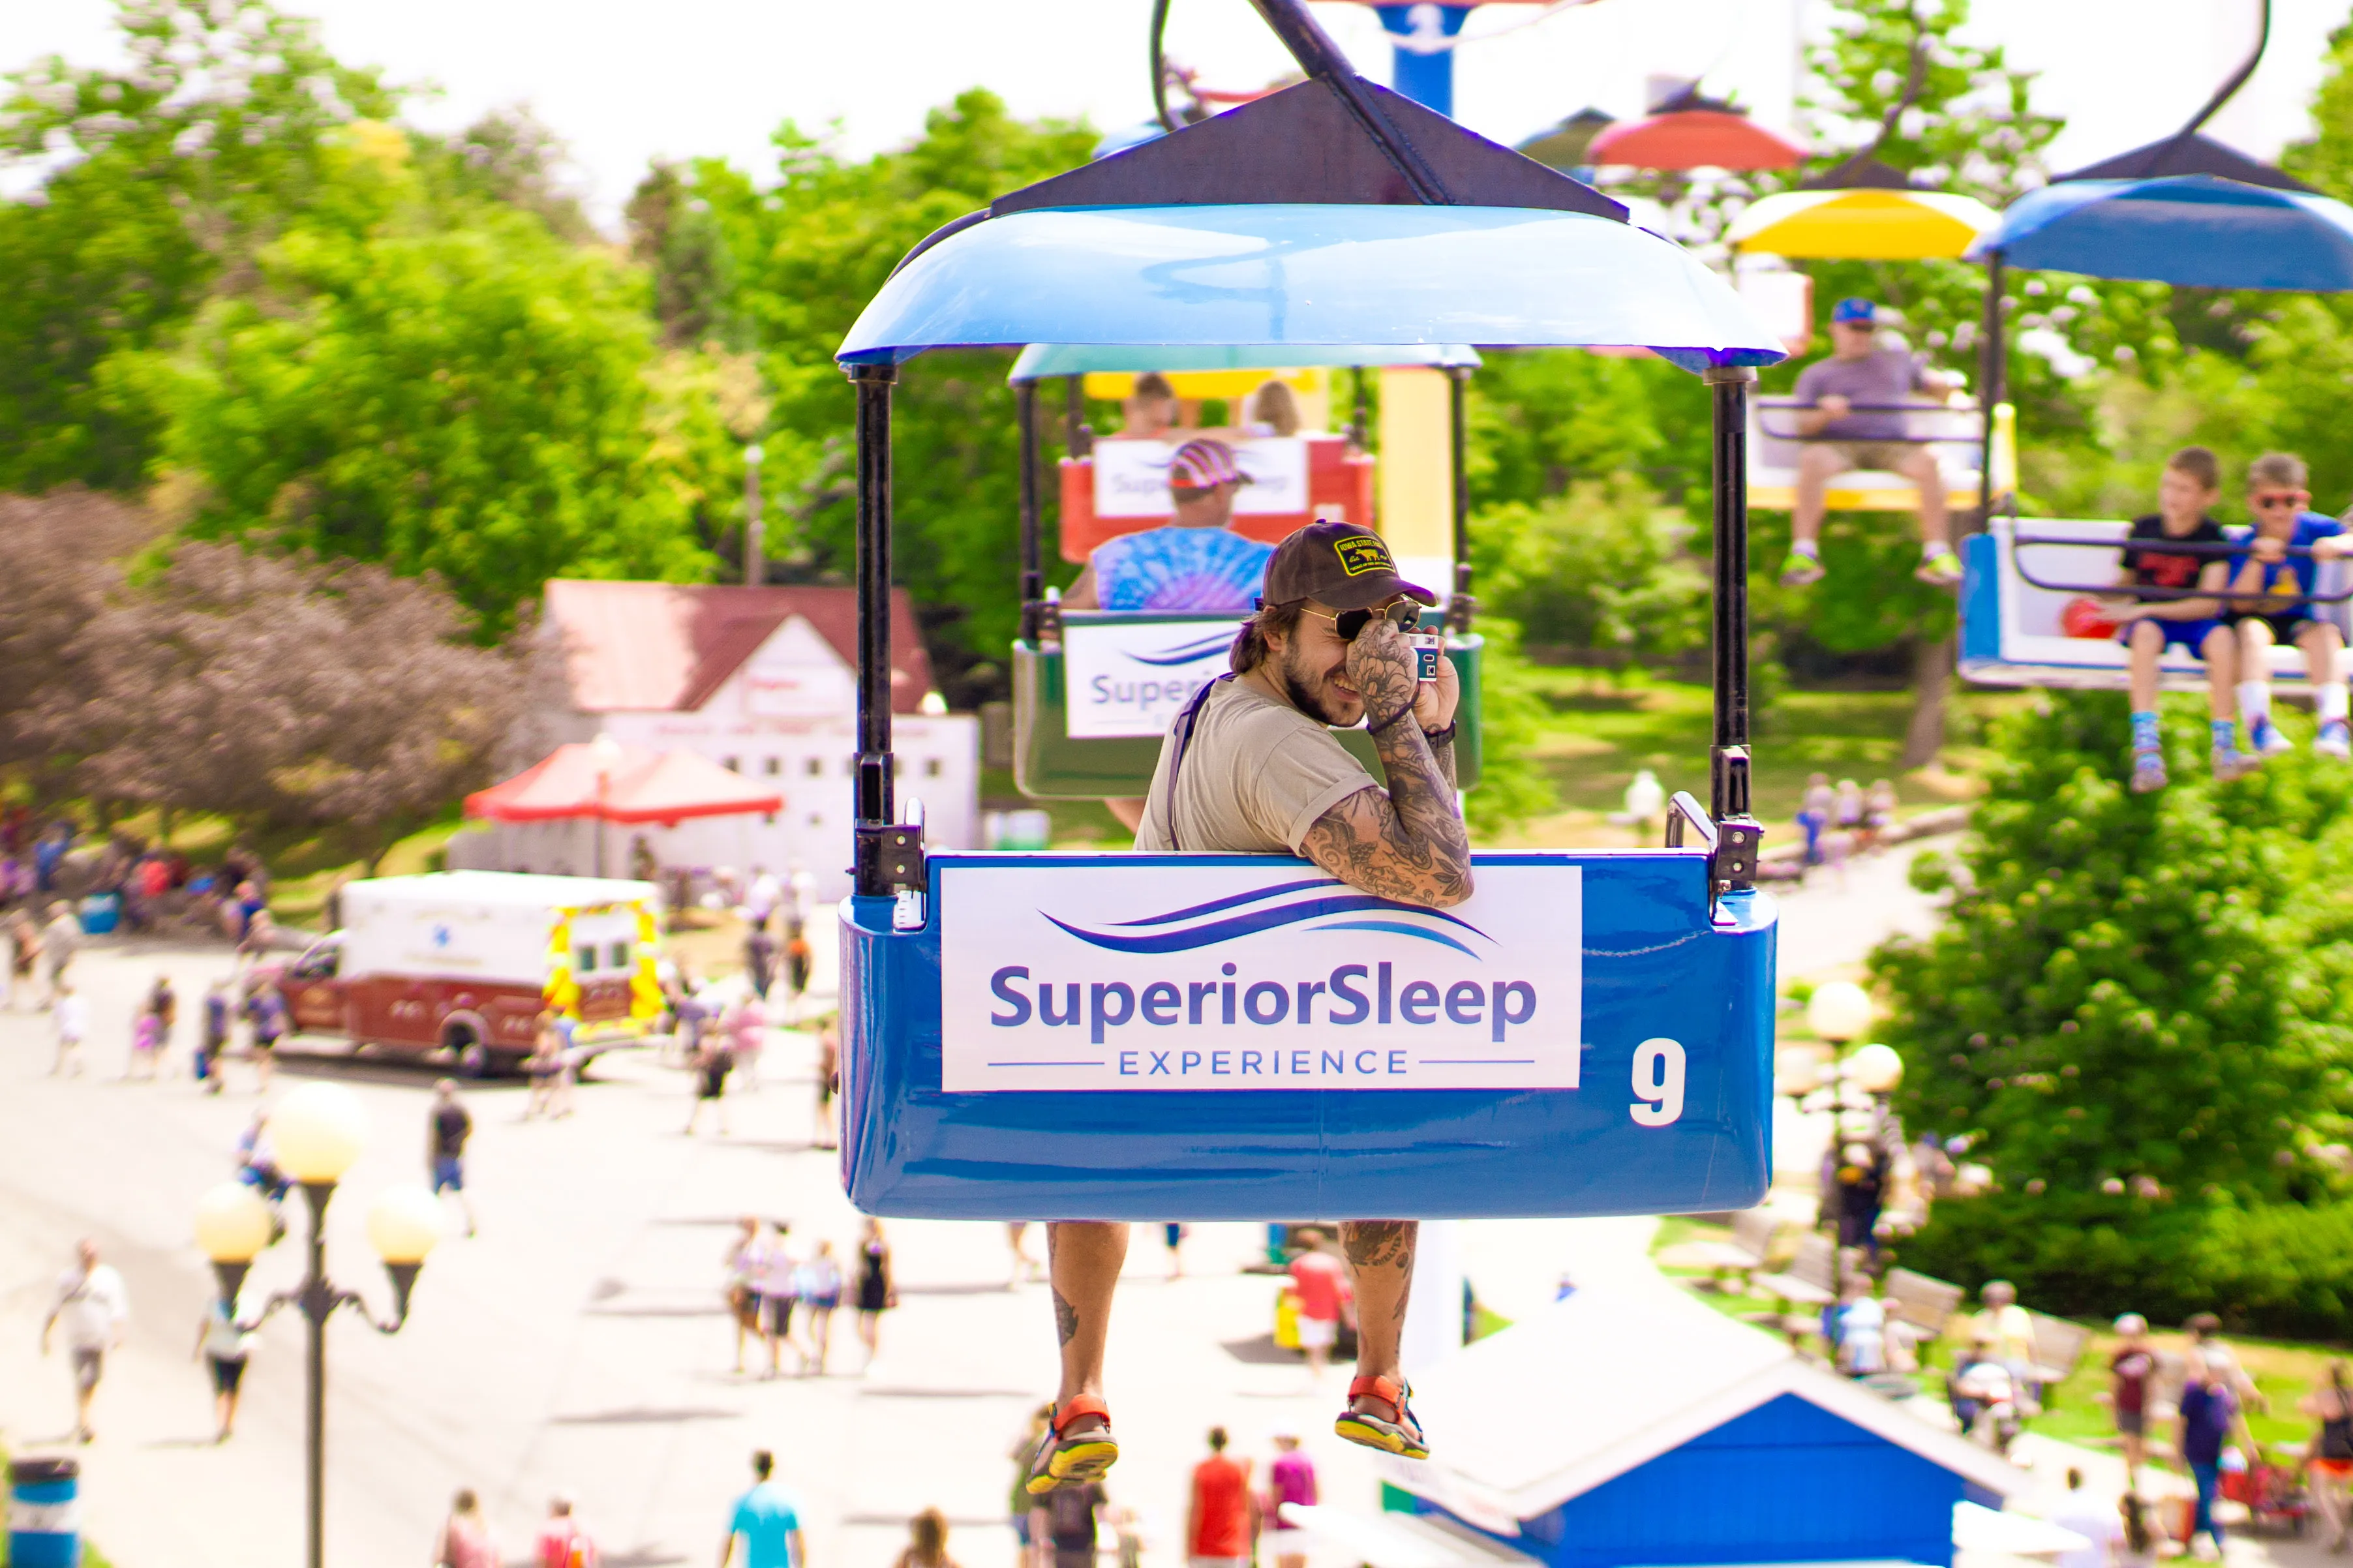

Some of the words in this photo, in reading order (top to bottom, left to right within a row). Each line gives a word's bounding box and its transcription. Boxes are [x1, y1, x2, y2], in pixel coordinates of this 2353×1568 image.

[1339, 541, 1357, 551] IOWA
[991, 963, 1536, 1044] SuperiorSleep
[1120, 1051, 1406, 1075] EXPERIENCE
[1630, 1038, 1686, 1127] 9
